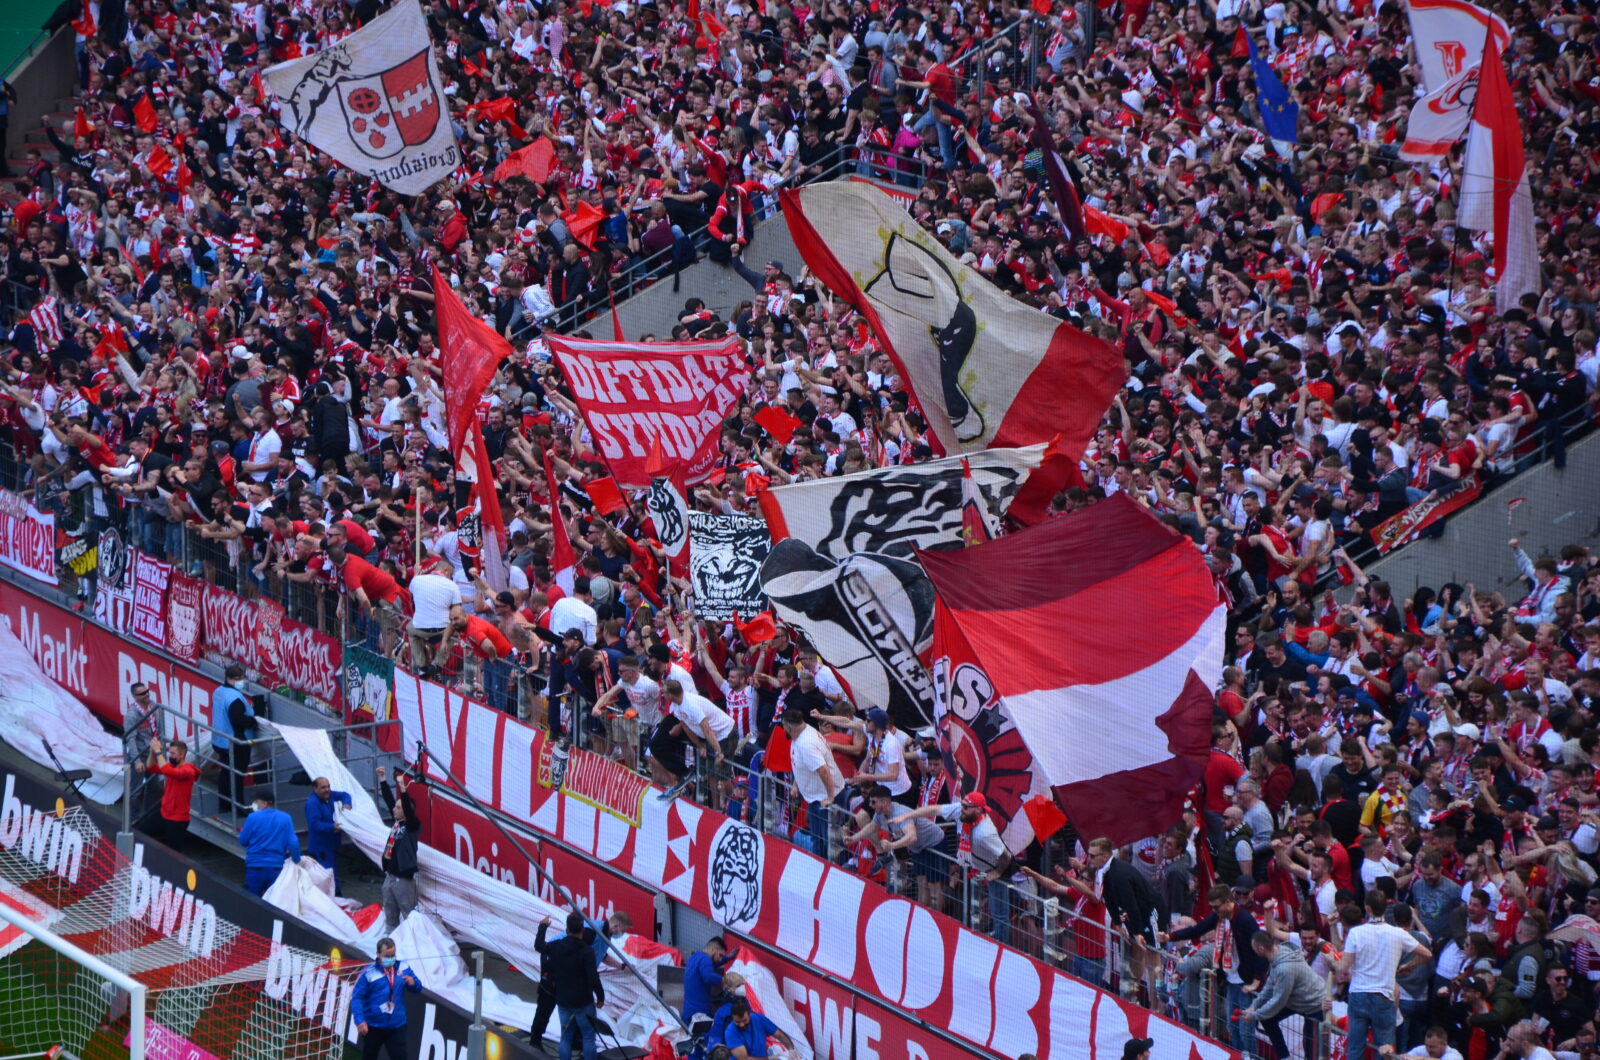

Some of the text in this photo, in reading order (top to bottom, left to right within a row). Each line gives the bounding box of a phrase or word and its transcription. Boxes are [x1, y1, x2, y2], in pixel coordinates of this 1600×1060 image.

[20, 605, 88, 697] Markt
[118, 651, 210, 741] REWE
[0, 773, 84, 885] bwin
[393, 666, 704, 906] WILDE
[129, 843, 216, 960] bwin
[782, 976, 882, 1060] EWE
